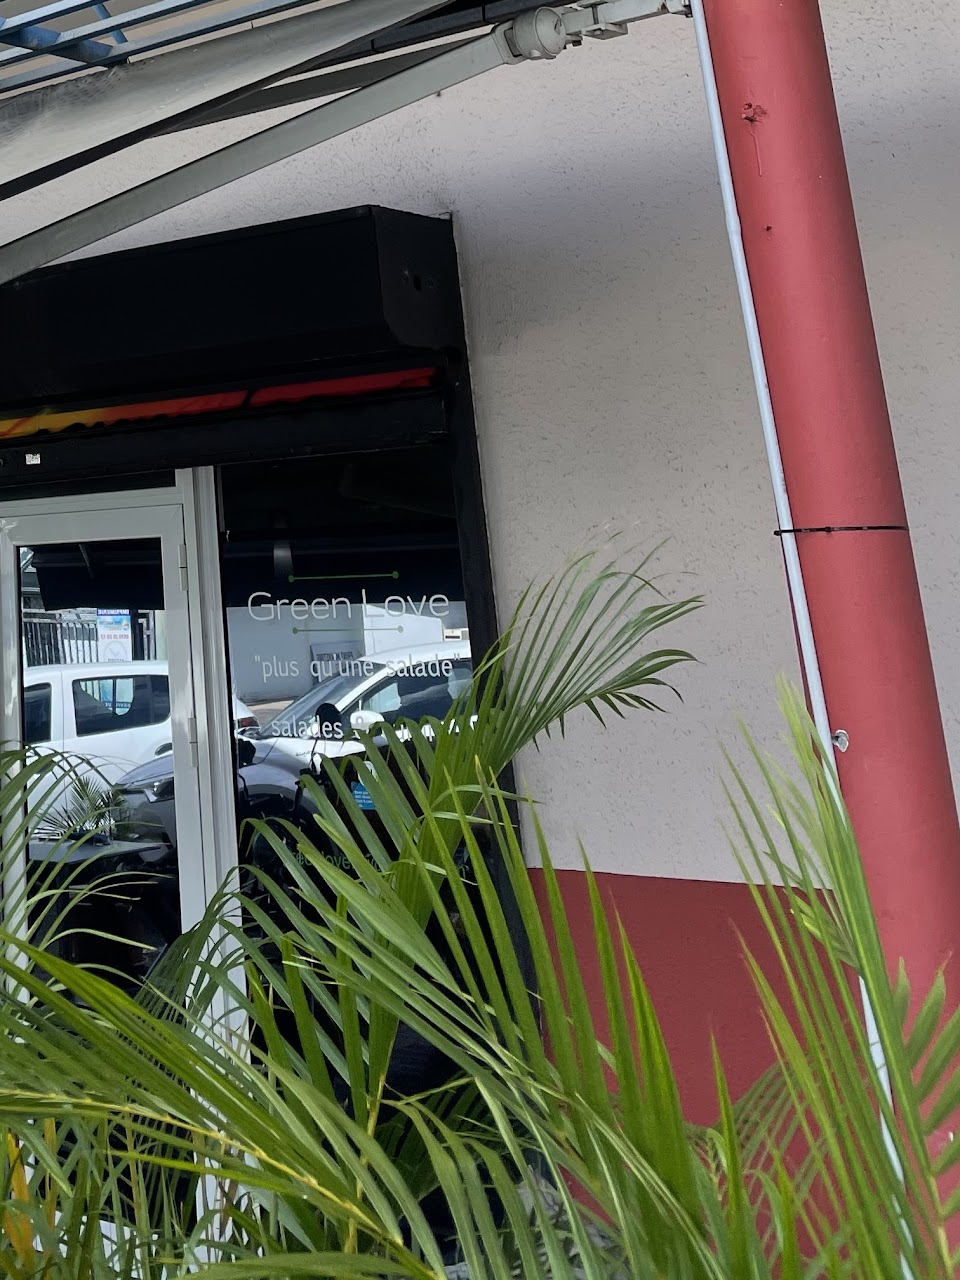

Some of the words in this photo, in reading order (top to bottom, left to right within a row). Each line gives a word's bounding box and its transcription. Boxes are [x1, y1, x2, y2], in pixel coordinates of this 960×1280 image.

[247, 591, 353, 621] Green
[361, 588, 450, 618] Love
[271, 714, 344, 739] salades
